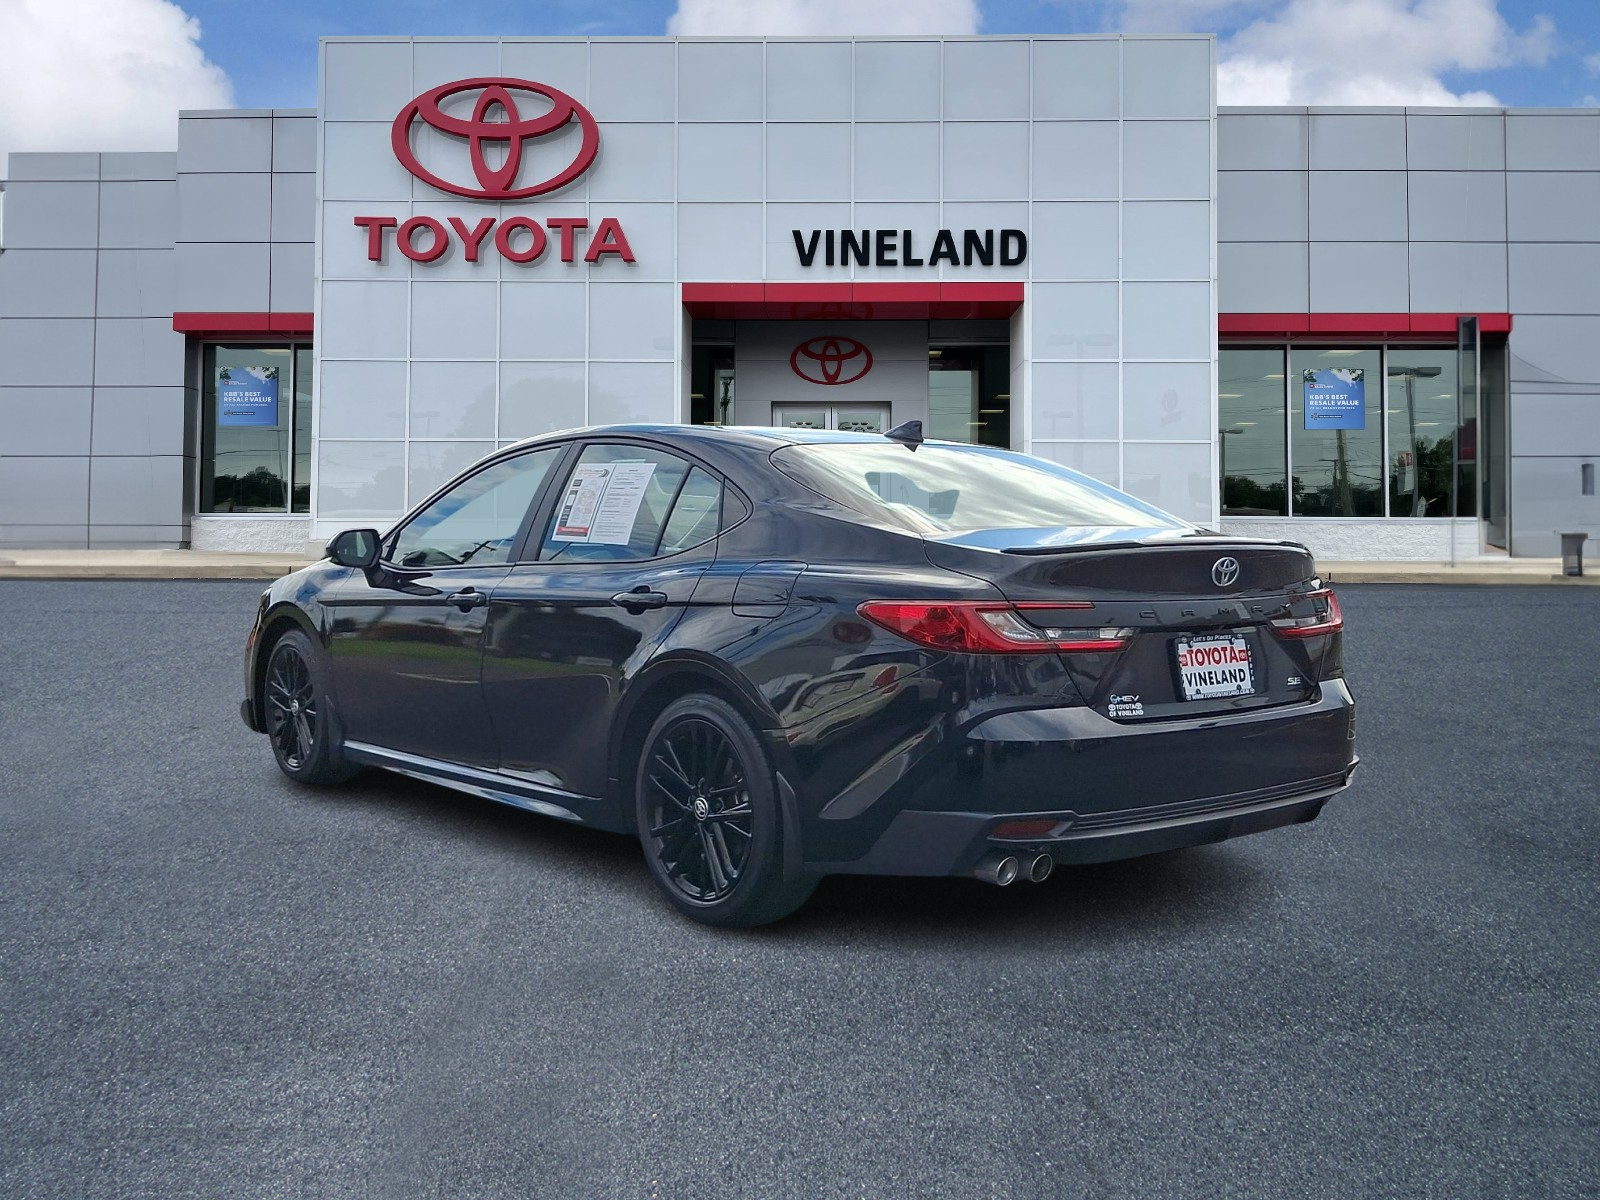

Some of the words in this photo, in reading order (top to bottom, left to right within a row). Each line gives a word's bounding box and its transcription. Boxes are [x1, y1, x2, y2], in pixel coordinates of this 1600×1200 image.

[354, 216, 637, 263] TOYOTA
[792, 229, 1028, 266] VINELAND
[1186, 646, 1239, 667] TOYOTA
[1185, 668, 1246, 688] VINELAND
[1287, 676, 1302, 685] SE
[1118, 709, 1144, 717] VINELAND
